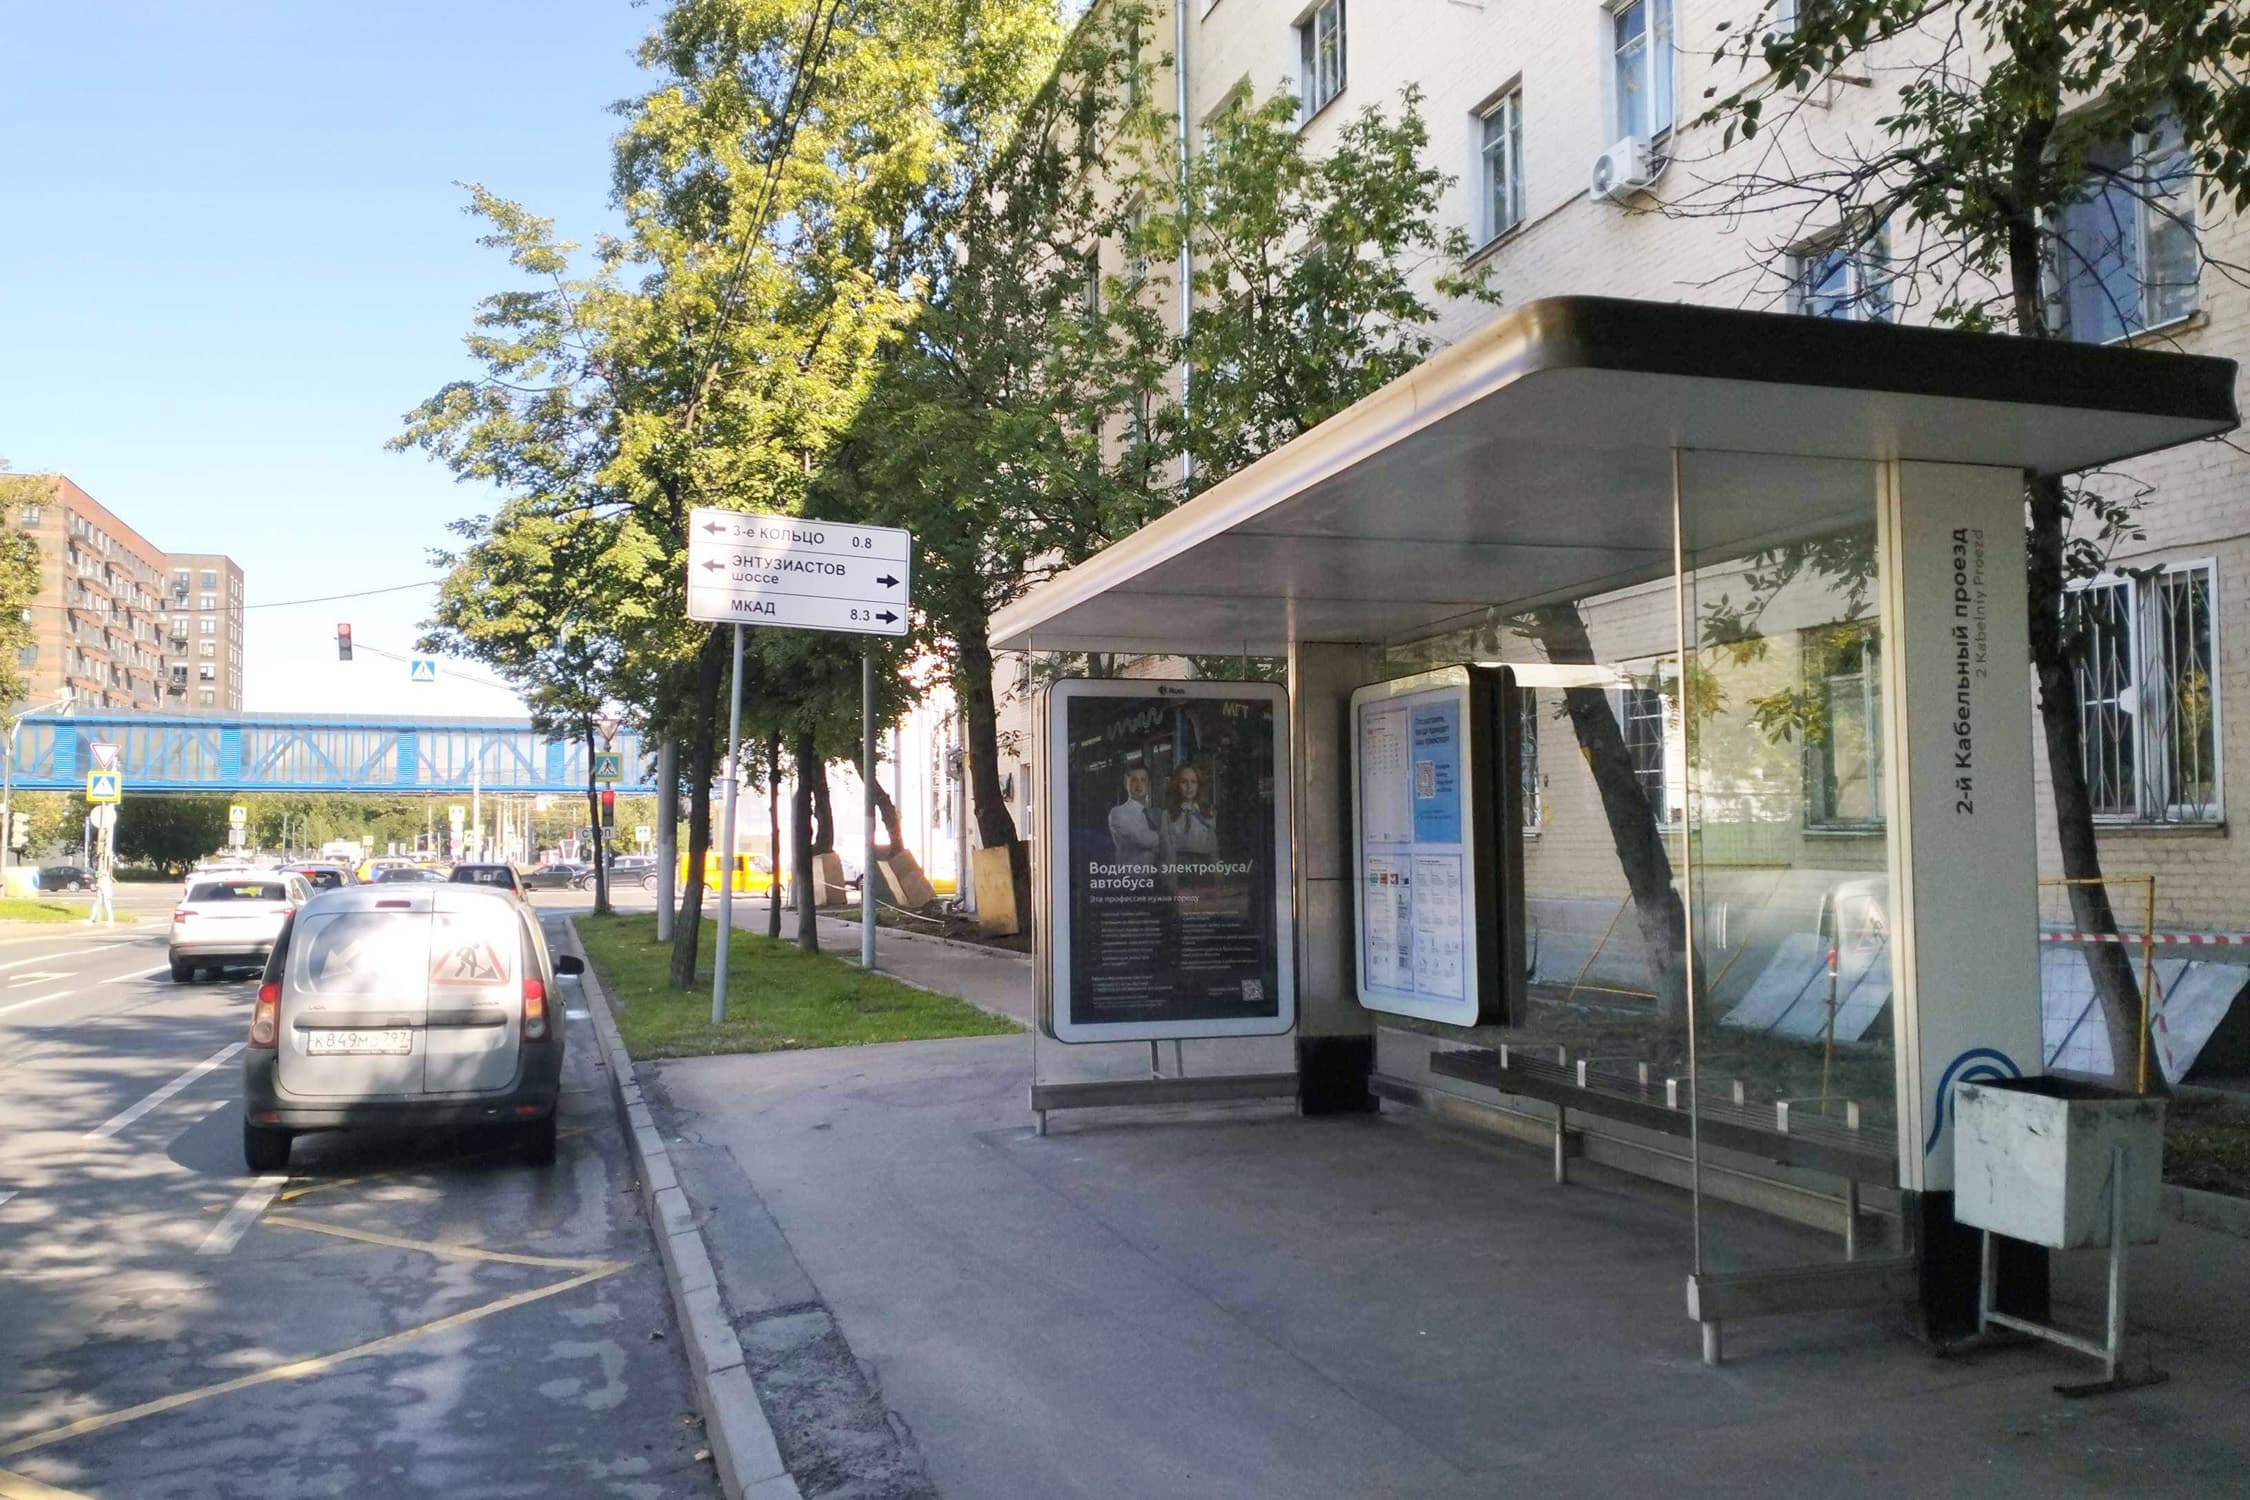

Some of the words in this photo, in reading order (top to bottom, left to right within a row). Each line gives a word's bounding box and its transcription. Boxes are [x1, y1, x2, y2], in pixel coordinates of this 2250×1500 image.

[733, 525, 755, 538] 3-е
[760, 528, 825, 545] КОЛЬЦО
[852, 536, 873, 549] 0.8
[732, 555, 846, 576] ЭНТУЗИАСТОВ
[1972, 529, 1986, 585] Proezd
[731, 573, 780, 585] шоссе
[1952, 528, 1971, 618] проезд
[731, 600, 776, 616] МКАД
[850, 608, 870, 621] 8.3
[1973, 590, 1988, 663] Kabelniy
[1976, 669, 1988, 678] 2
[1952, 625, 1972, 769] Кабельный
[1956, 777, 1973, 815] 2-й
[582, 829, 610, 838] СП
[1089, 862, 1158, 876] Водитель
[1161, 859, 1253, 876] электробуса/
[1089, 876, 1154, 891] автобуса
